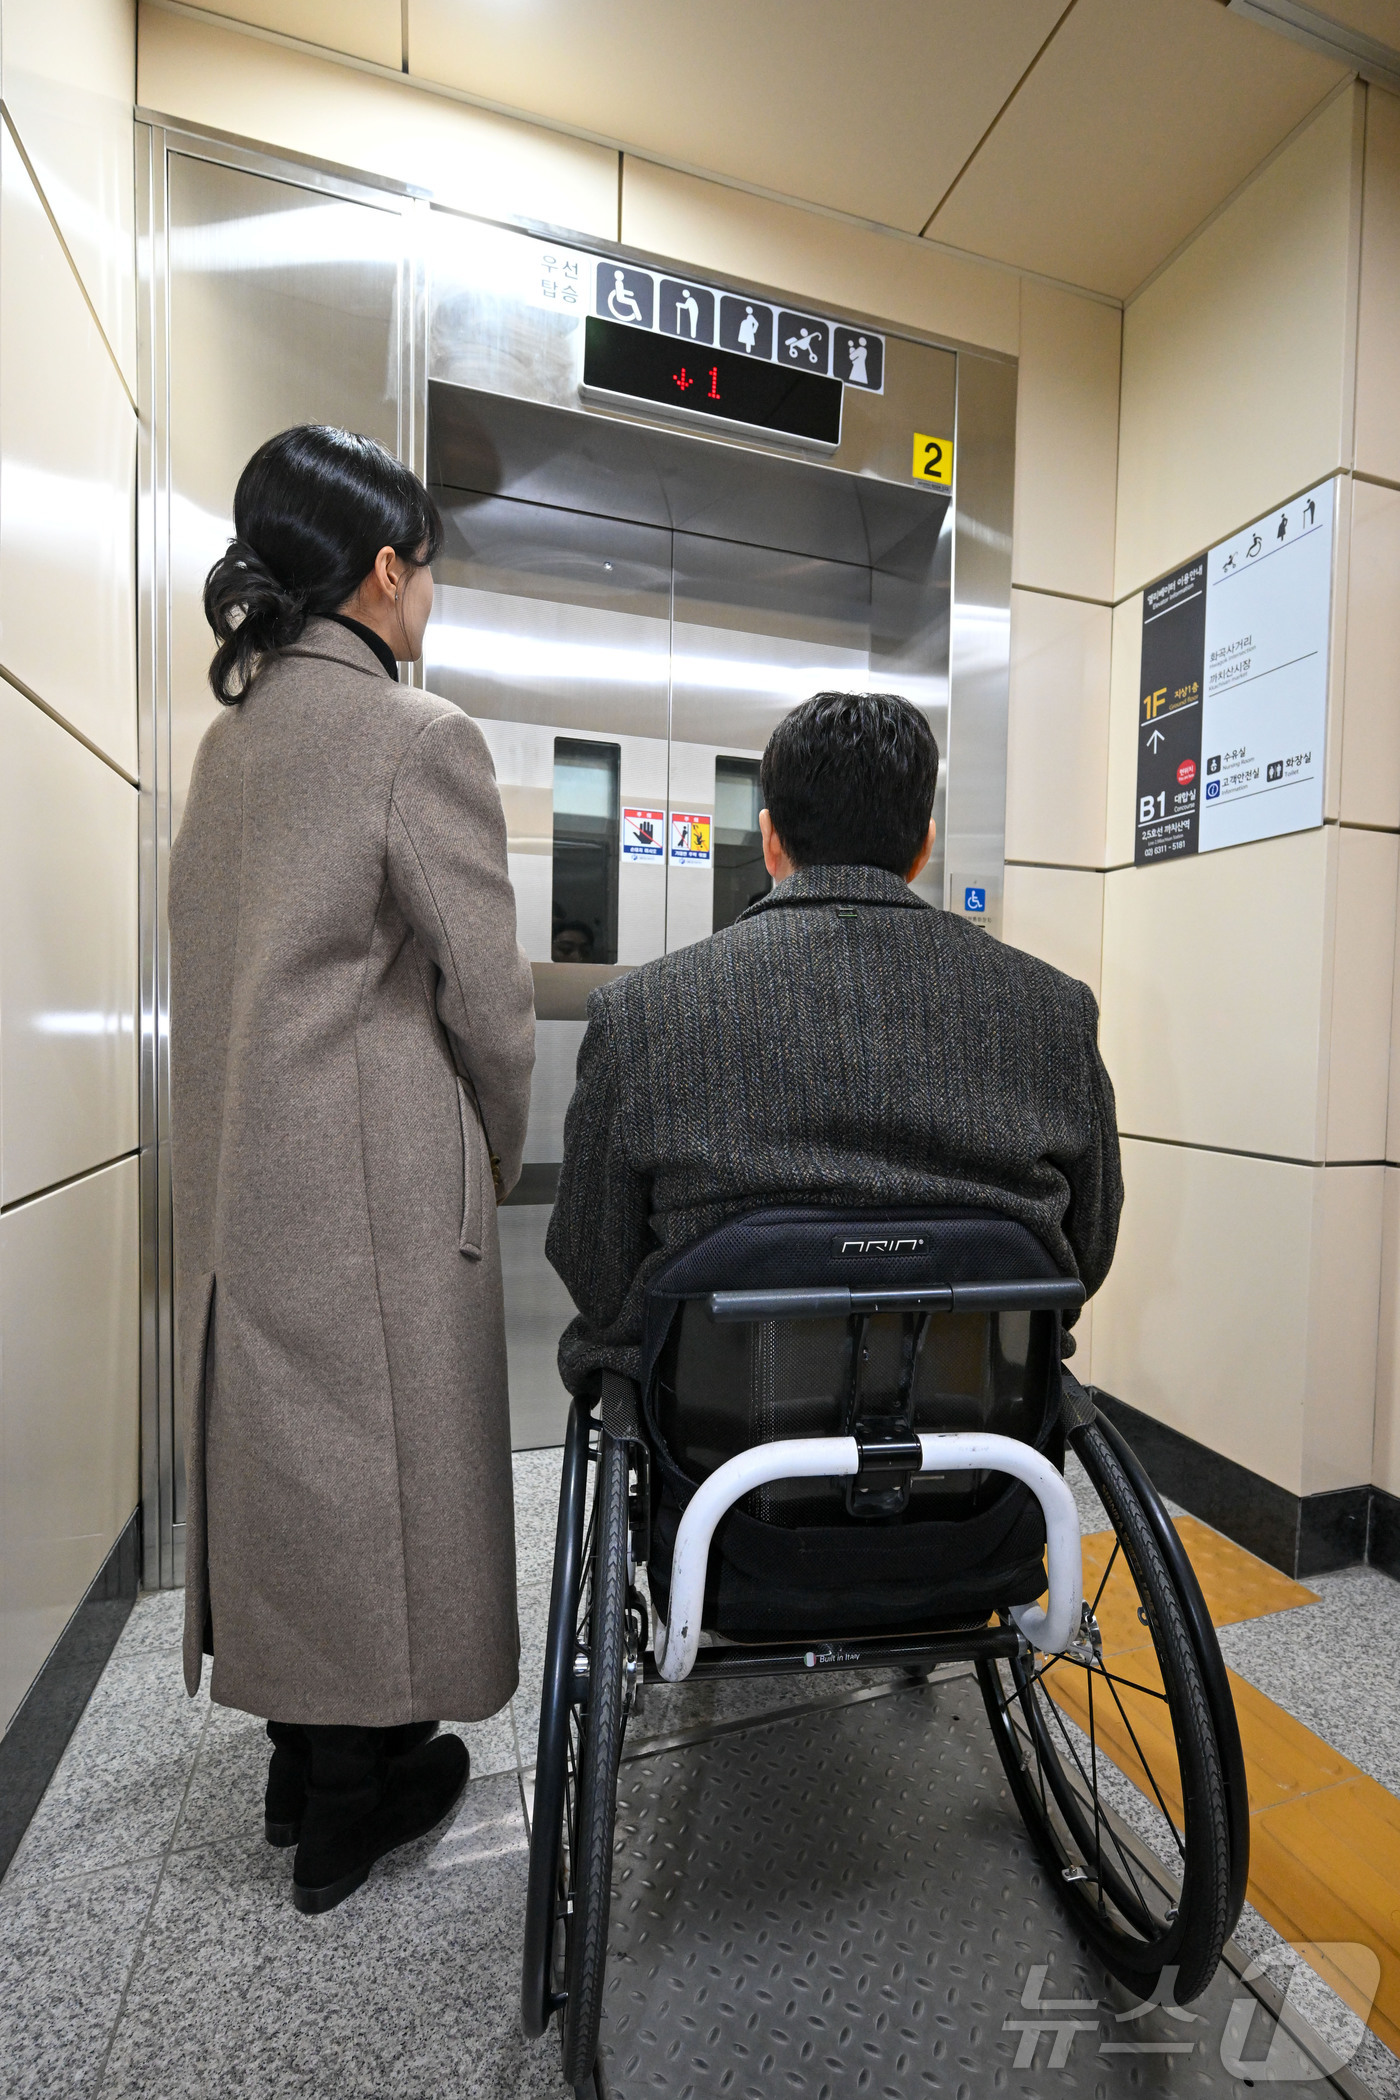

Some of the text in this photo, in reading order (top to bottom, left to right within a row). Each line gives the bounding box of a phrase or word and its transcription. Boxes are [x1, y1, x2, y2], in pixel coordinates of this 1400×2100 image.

[541, 254, 579, 281] 우선
[541, 278, 579, 304] 탑승
[707, 366, 721, 400] 1
[924, 442, 943, 478] 2
[1147, 564, 1204, 606] 엘리베이터 이용안내
[1210, 634, 1252, 662] 화곡사거리
[1209, 658, 1252, 684] 까치산시장
[1143, 687, 1167, 720] 1F
[1224, 746, 1246, 762] 수유실
[1285, 751, 1312, 768] 화장실
[1222, 767, 1260, 787] 고객안전실
[1139, 790, 1166, 823] B1
[1174, 788, 1196, 804] 대합실
[1164, 818, 1191, 834] 까치산역
[819, 1654, 836, 1663] Built
